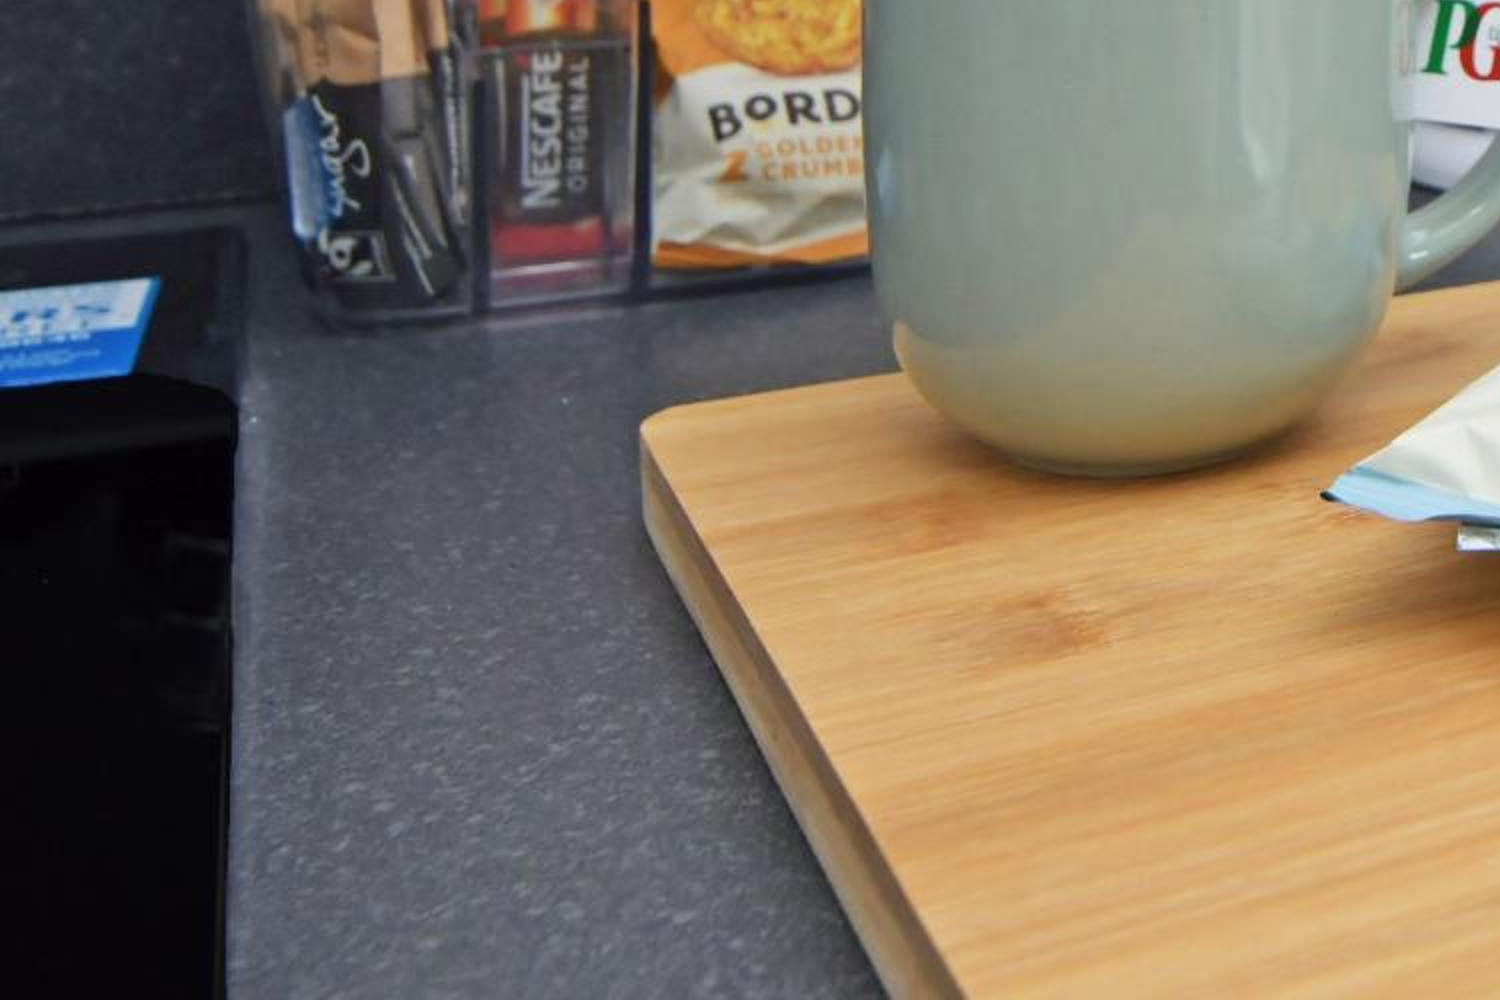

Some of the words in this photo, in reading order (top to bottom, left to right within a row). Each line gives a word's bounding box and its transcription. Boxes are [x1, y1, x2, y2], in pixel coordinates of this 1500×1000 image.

[567, 55, 591, 192] ORIGINAL
[708, 88, 860, 143] BORD
[761, 157, 864, 183] CRUMB
